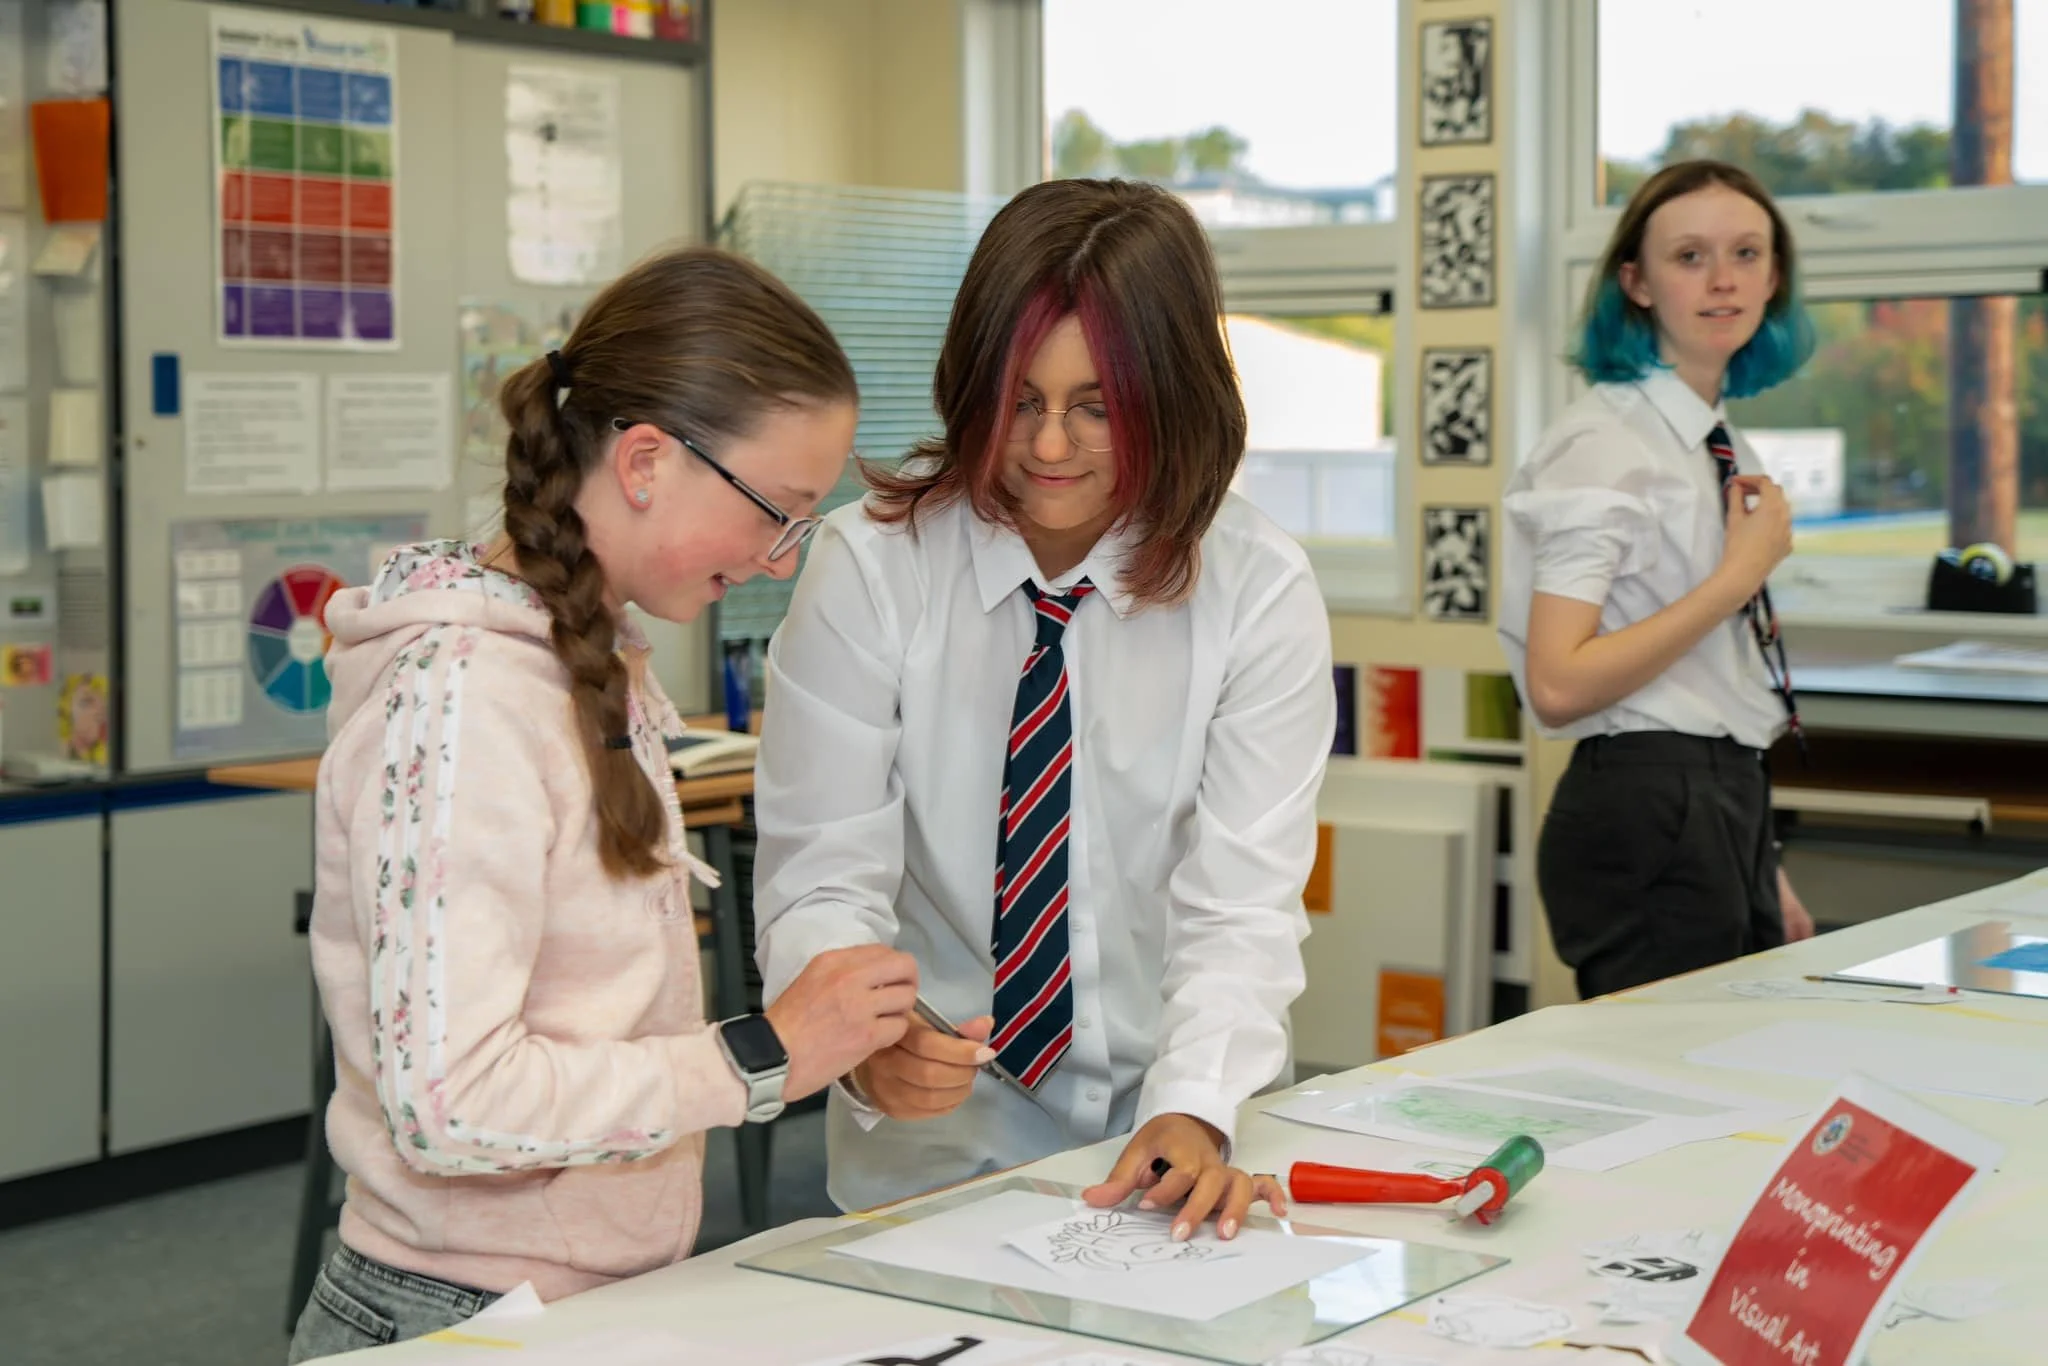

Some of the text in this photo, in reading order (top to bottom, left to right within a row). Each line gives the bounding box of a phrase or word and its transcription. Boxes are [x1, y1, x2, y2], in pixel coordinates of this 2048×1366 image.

[1769, 1176, 1897, 1280] Monoprinting
[1784, 1248, 1809, 1290] in
[1780, 1329, 1821, 1366] Art
